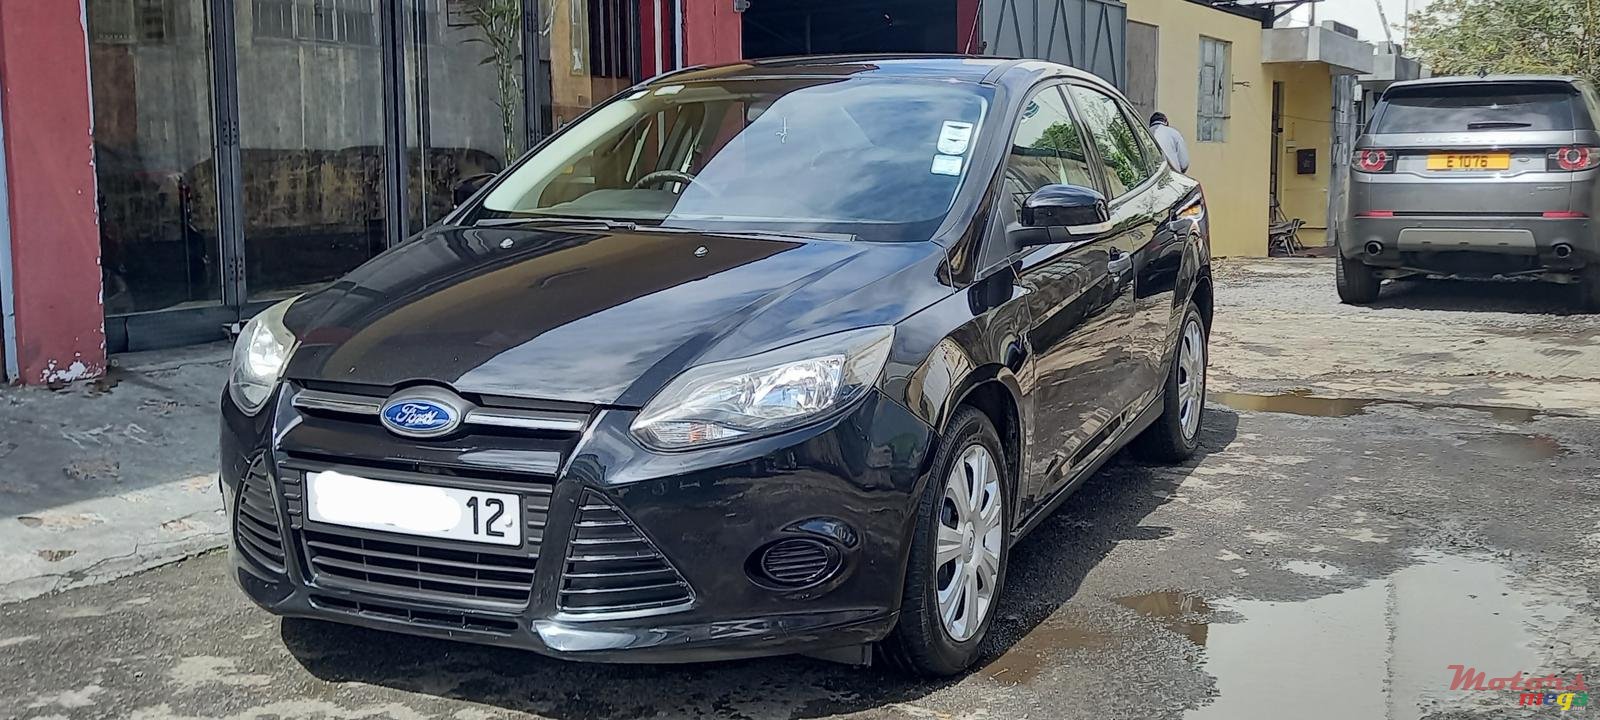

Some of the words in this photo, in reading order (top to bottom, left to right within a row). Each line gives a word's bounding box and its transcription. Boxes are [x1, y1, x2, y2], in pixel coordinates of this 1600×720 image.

[1446, 155, 1454, 168] E
[1459, 155, 1489, 168] 1076
[395, 403, 439, 426] Ford
[466, 496, 505, 538] 12
